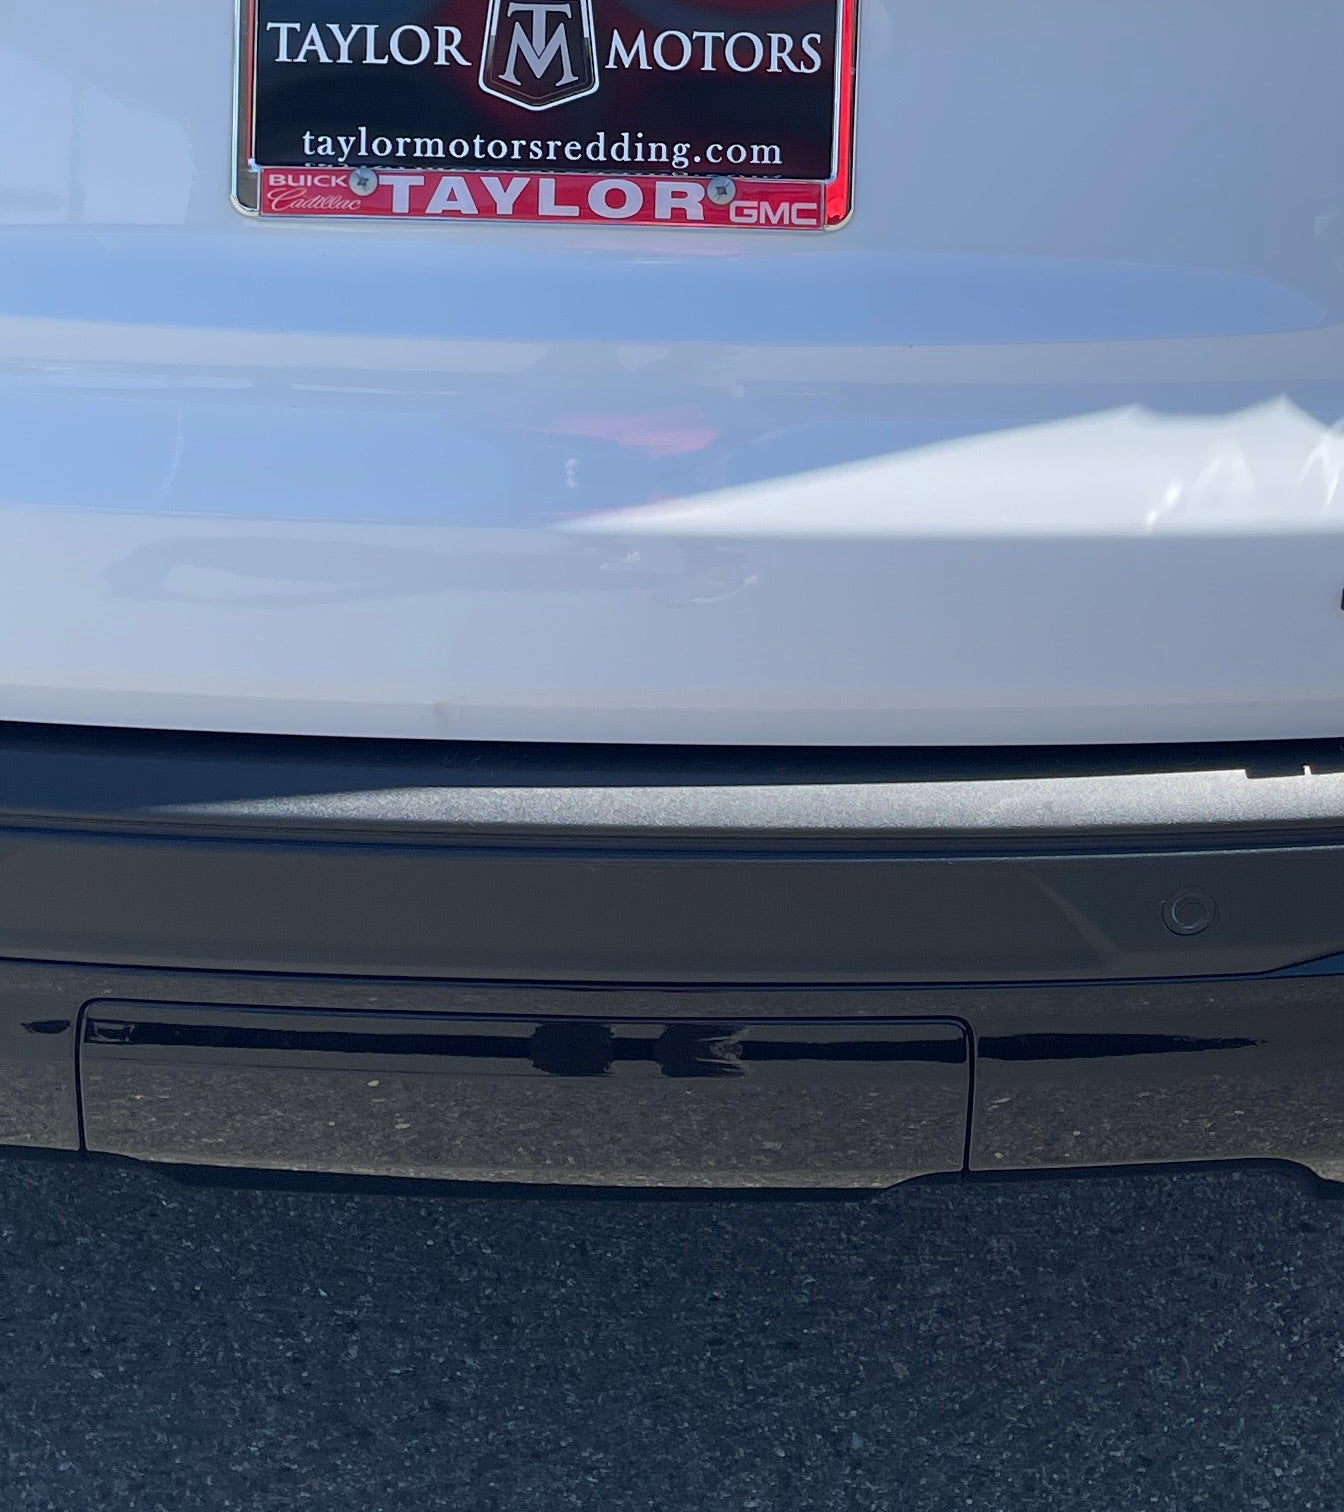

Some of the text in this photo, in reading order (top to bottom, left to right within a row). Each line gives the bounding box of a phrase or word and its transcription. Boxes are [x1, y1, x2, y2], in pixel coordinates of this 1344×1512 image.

[266, 22, 472, 66] TAYLOR
[605, 29, 822, 73] MOTORS
[302, 126, 783, 169] taylormotorsredding.com
[269, 174, 348, 188] BUICK
[379, 175, 706, 220] TAYLOR
[267, 188, 361, 212] Cadillac
[729, 200, 817, 225] GMC
